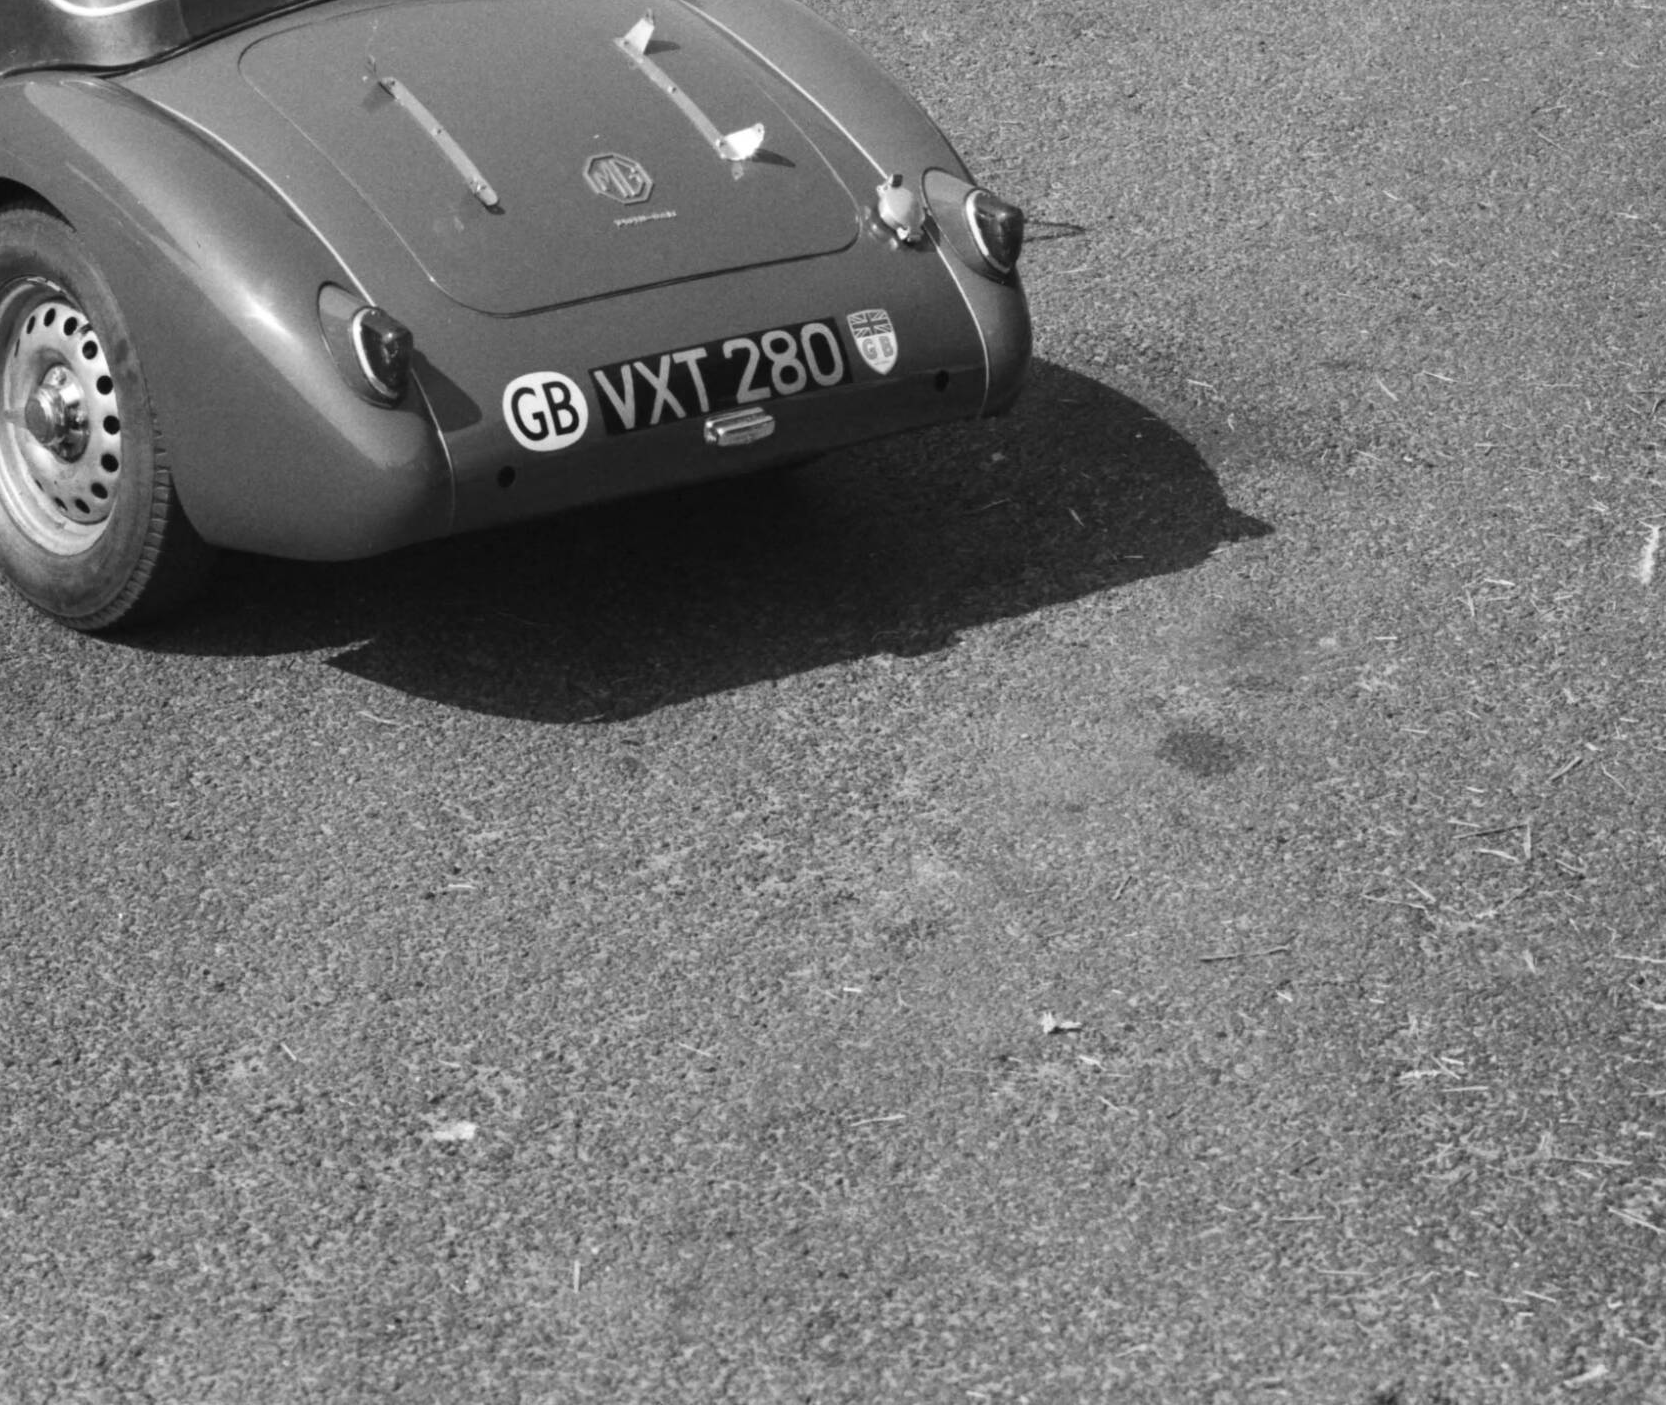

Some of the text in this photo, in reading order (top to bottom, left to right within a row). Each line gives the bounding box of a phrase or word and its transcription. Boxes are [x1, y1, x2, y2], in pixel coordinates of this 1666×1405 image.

[589, 155, 648, 200] MG
[861, 335, 895, 361] GB
[593, 322, 844, 430] VXT 280
[510, 380, 581, 442] GB
